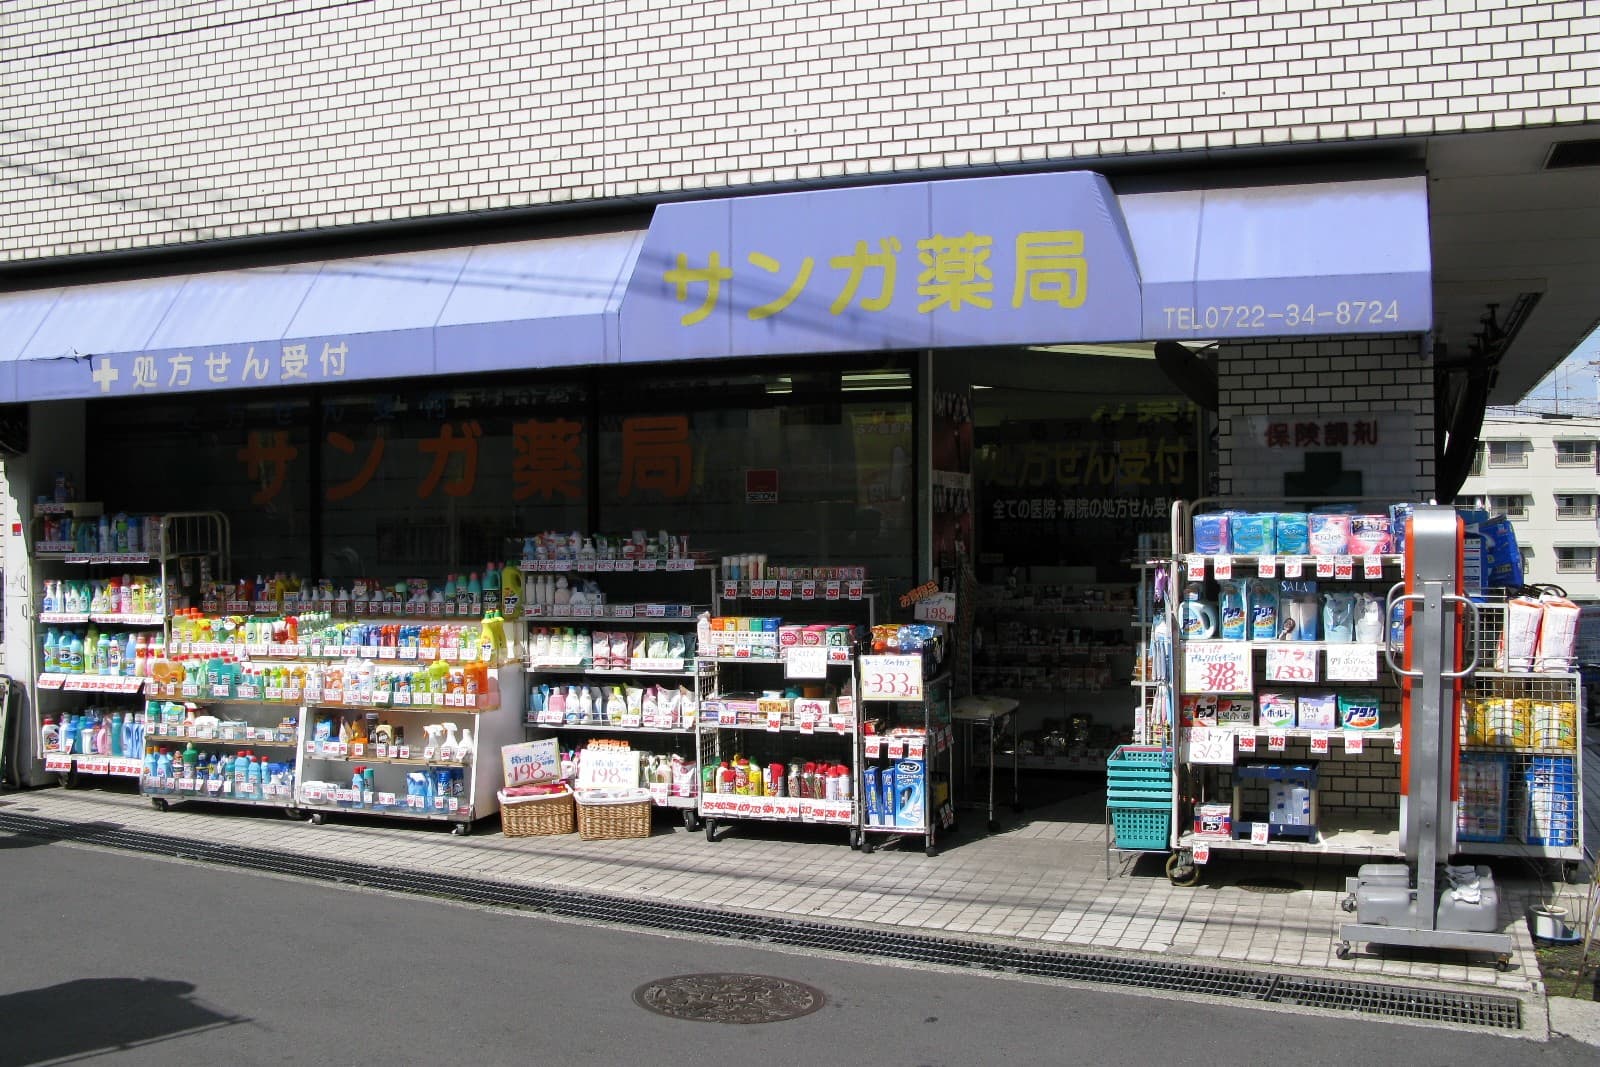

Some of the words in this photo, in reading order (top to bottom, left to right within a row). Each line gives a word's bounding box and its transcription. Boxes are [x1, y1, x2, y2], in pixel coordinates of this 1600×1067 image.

[663, 229, 1088, 327] サンガ薬局
[1163, 300, 1399, 330] TEL0722-34-8724
[132, 341, 349, 388] 処方せん受付
[1265, 420, 1378, 447] 保険調剤
[237, 415, 692, 505] サンガ薬局
[1281, 581, 1308, 593] SALA
[1345, 707, 1377, 722] アタック
